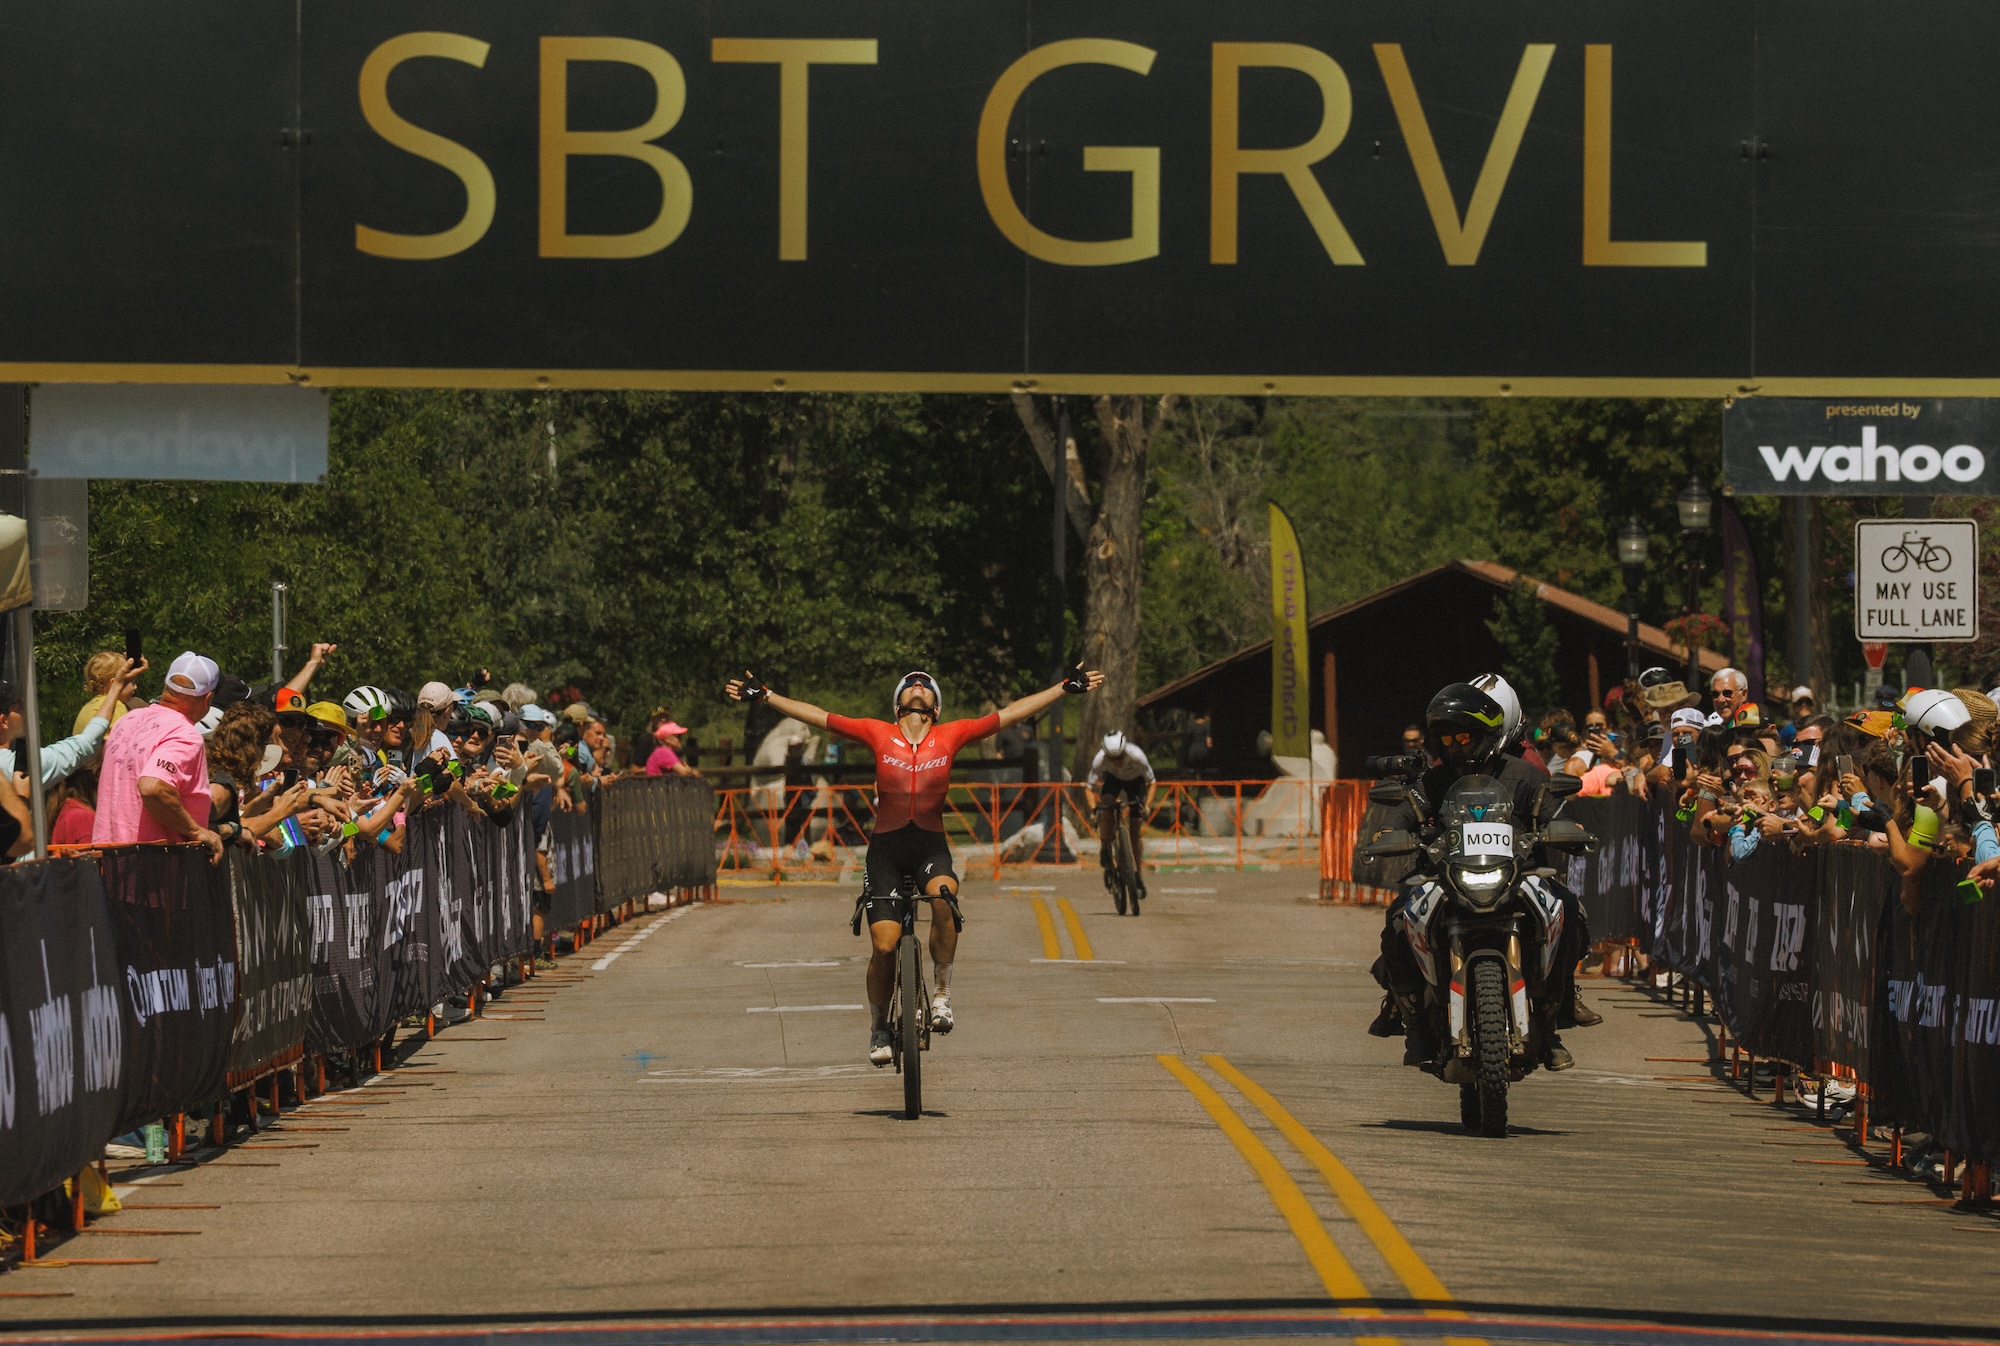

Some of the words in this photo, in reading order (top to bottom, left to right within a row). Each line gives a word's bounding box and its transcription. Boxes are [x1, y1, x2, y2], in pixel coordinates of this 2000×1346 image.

[355, 31, 878, 260] SBT
[976, 37, 1707, 266] GRVL
[1825, 403, 1899, 419] presented
[1902, 403, 1921, 420] by
[1758, 426, 1985, 482] wahoo
[1876, 583, 1911, 600] MAY
[1923, 583, 1957, 600] USE
[1867, 609, 1910, 627] FULL
[1922, 609, 1966, 627] LANE
[882, 754, 948, 772] SPECIALIZED
[1467, 833, 1511, 847] MOTO
